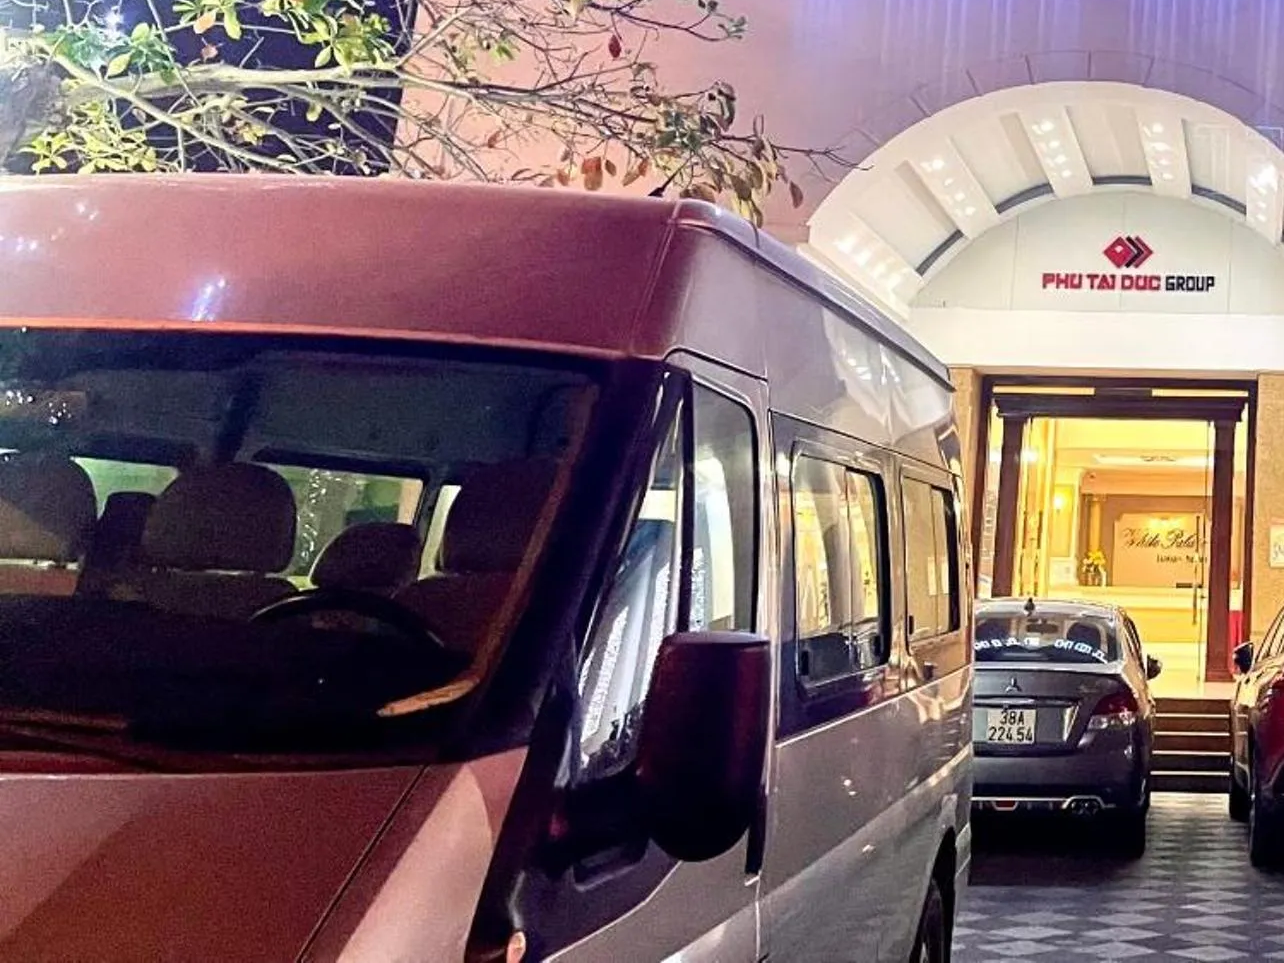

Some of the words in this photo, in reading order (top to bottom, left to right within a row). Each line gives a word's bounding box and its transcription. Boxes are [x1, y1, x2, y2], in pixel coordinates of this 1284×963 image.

[1042, 273, 1082, 289] PHU
[1087, 274, 1115, 291] TAI
[1121, 275, 1161, 291] DUC
[1165, 276, 1215, 292] GROUP
[1000, 710, 1025, 725] 38A
